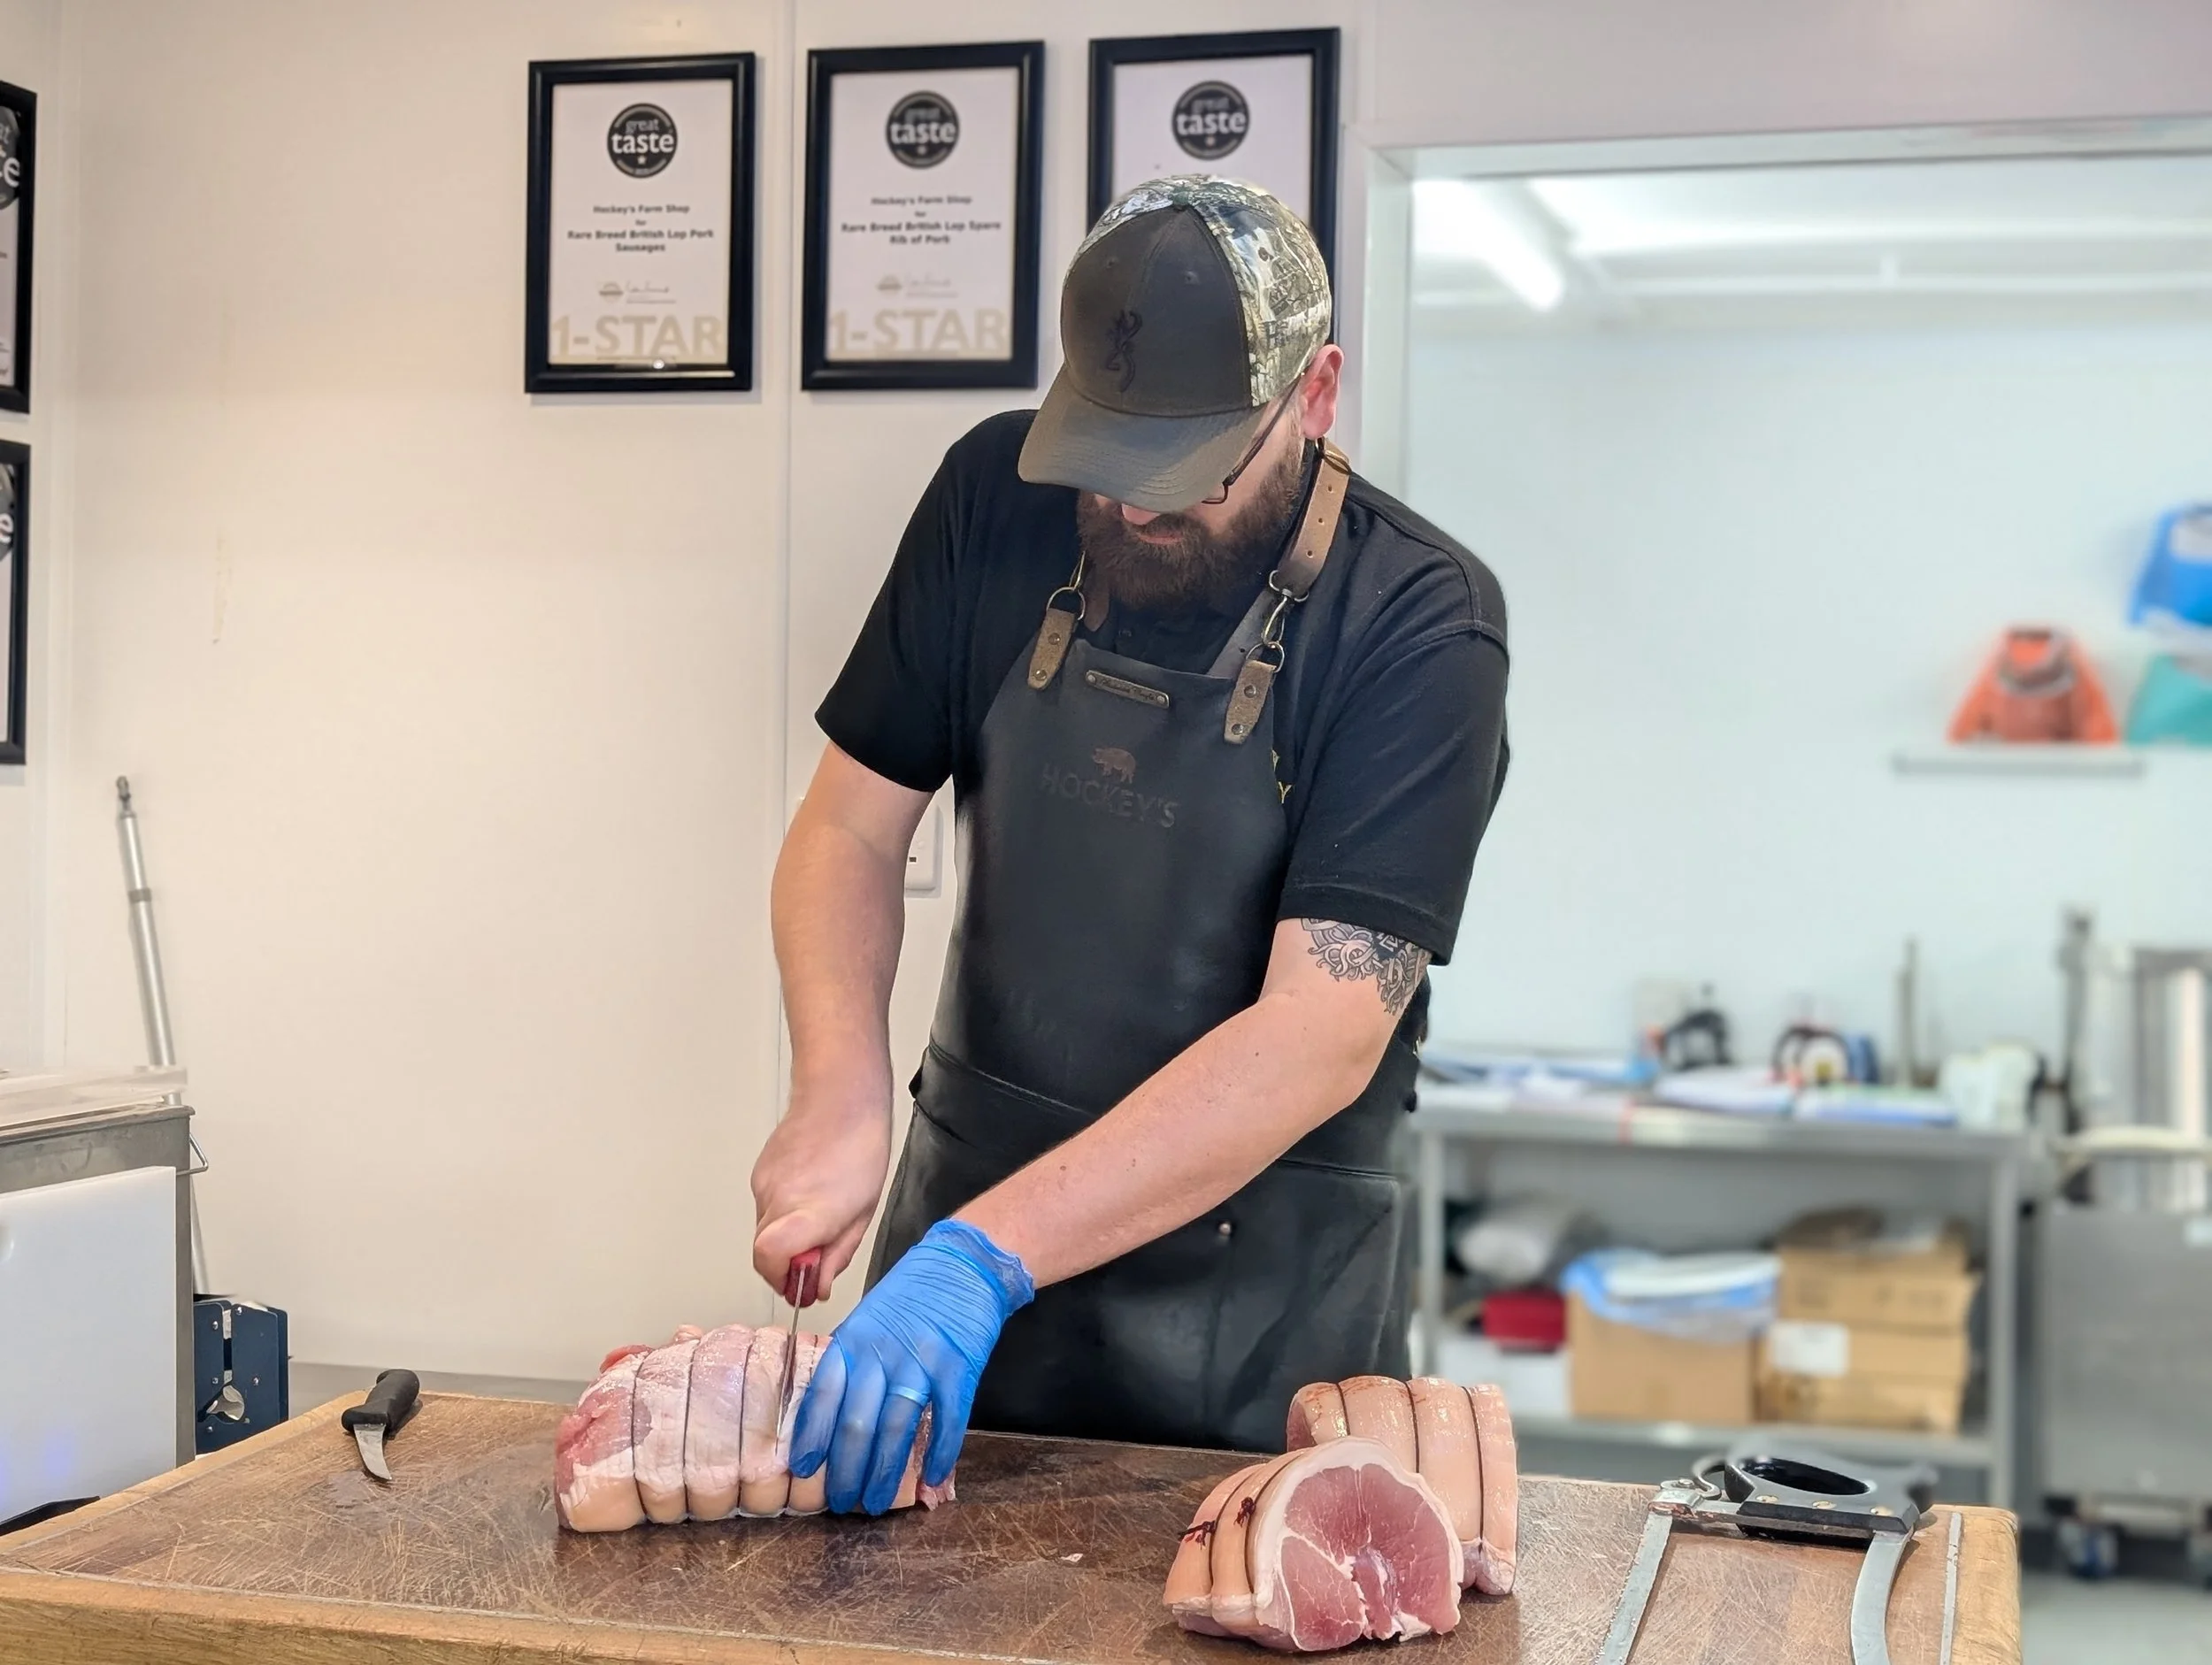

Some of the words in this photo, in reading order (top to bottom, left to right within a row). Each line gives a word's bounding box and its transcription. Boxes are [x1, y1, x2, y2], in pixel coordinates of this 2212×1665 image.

[890, 121, 956, 144] taste
[1177, 112, 1246, 135] taste
[611, 133, 674, 154] taste
[638, 204, 664, 213] Farm
[665, 204, 690, 213] Shop
[567, 231, 592, 240] Rare
[595, 230, 626, 240] Breed
[629, 230, 664, 239] British
[689, 229, 714, 239] Pork
[841, 223, 866, 233] Rare
[870, 222, 902, 232] Breed
[616, 242, 665, 254] Sausages
[551, 313, 723, 356] 1-STAR
[829, 308, 1008, 354] 1-STAR
